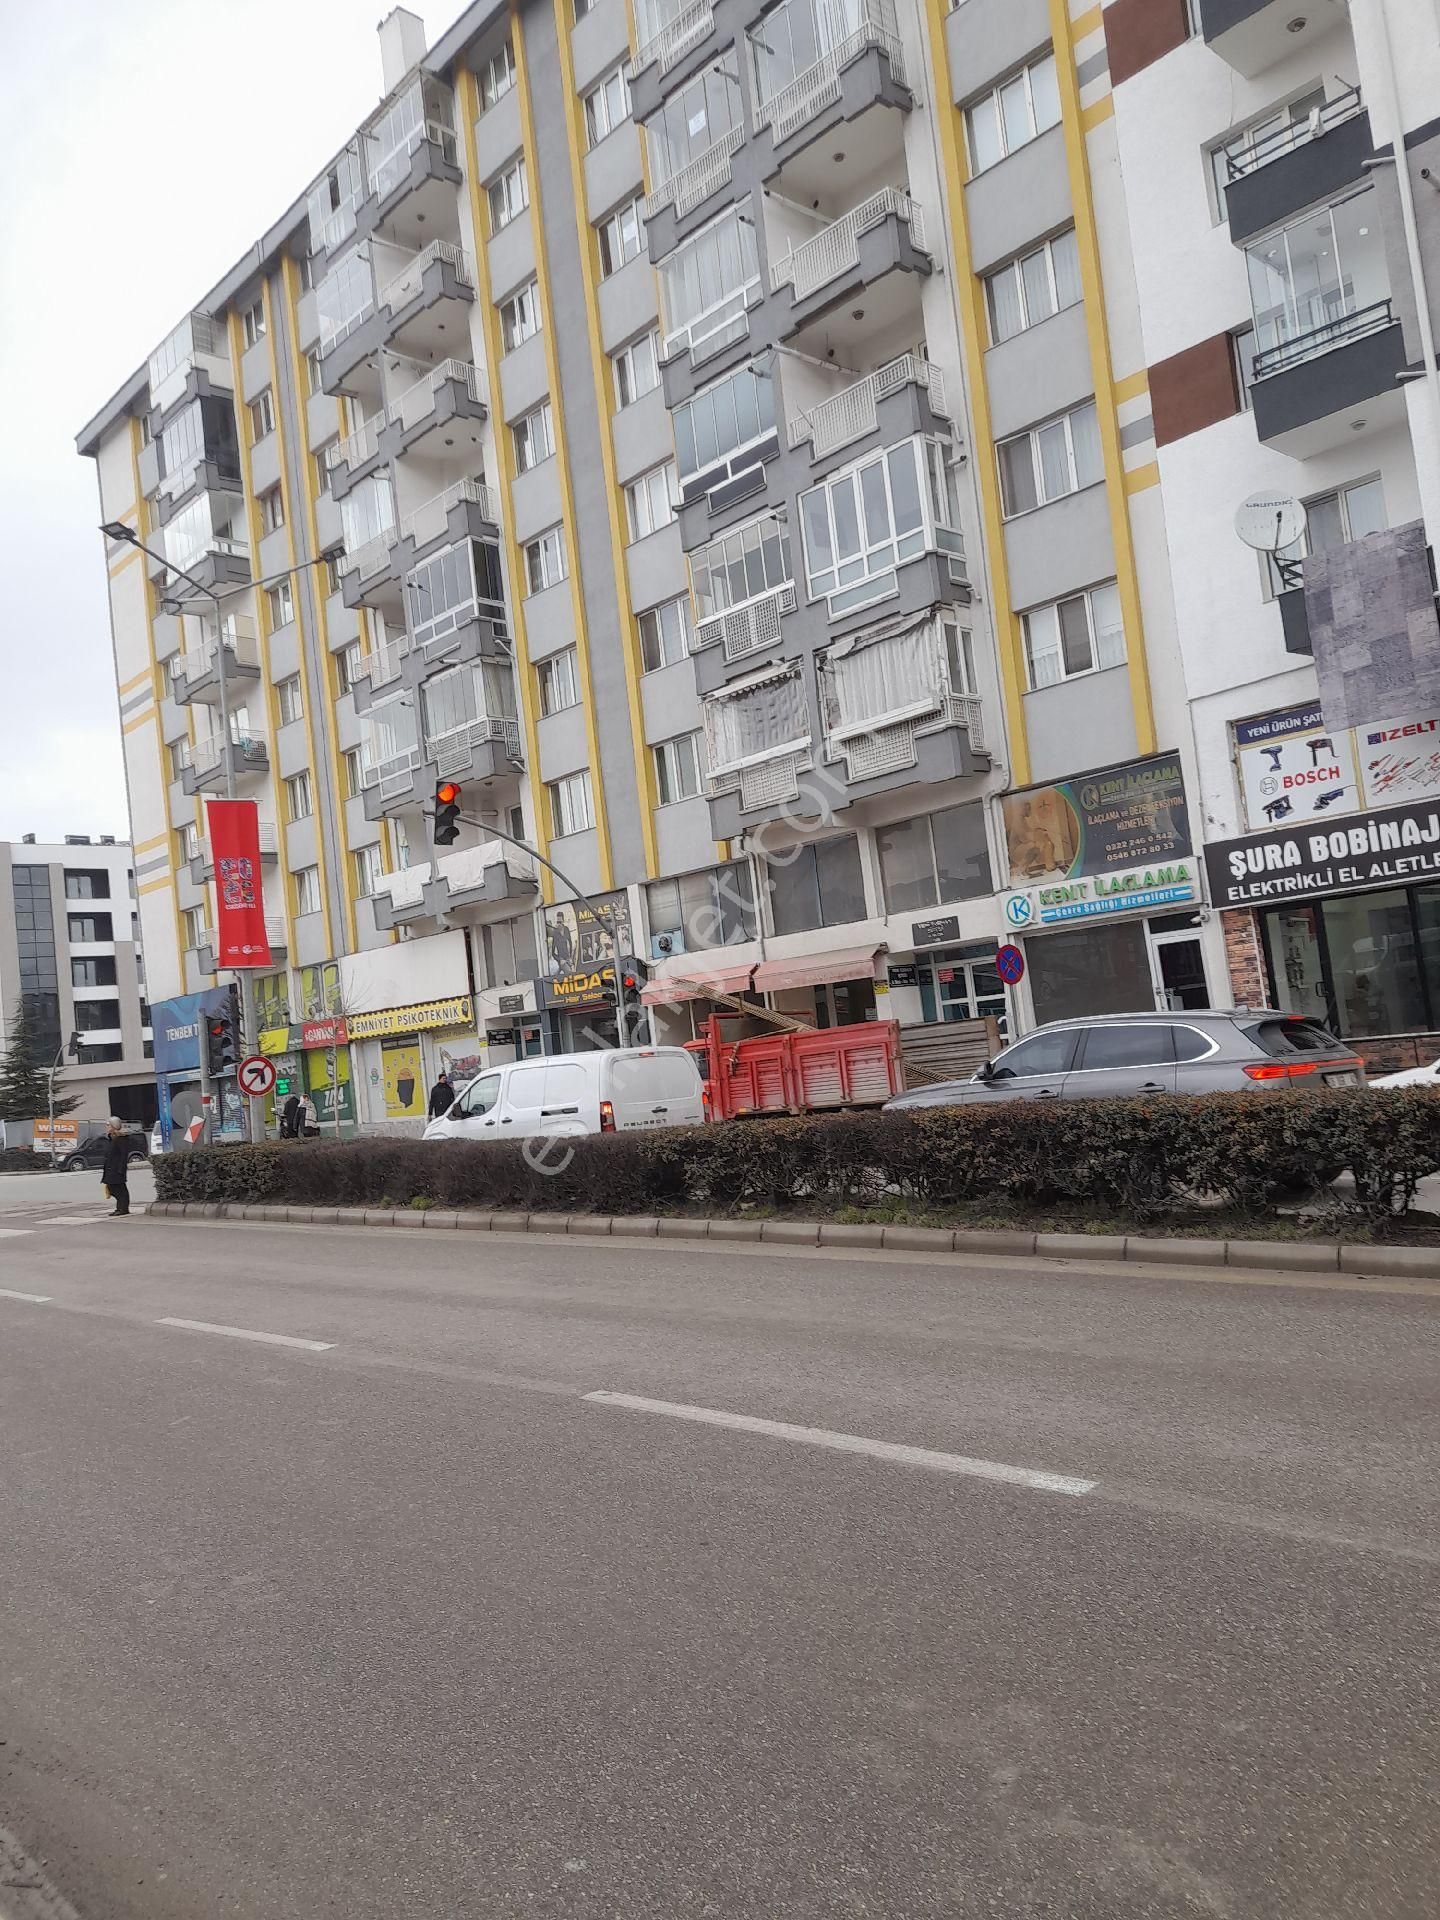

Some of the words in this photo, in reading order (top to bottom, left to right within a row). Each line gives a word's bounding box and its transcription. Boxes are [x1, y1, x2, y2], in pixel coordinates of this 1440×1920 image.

[1247, 723, 1270, 738] YENİ
[1272, 717, 1300, 732] ÜRÜN
[1282, 765, 1340, 789] BOSCH
[1228, 840, 1302, 881] ŞURA
[1308, 813, 1440, 863] BOBİNAJ
[1039, 883, 1087, 906] KENT
[1227, 867, 1334, 901] ELEKTRİKLİ
[1338, 866, 1365, 883] EL
[356, 1017, 393, 1033] EMNİYET
[397, 1005, 460, 1027] PSİKOTEKNİK
[623, 1118, 668, 1127] PEUGEOT
